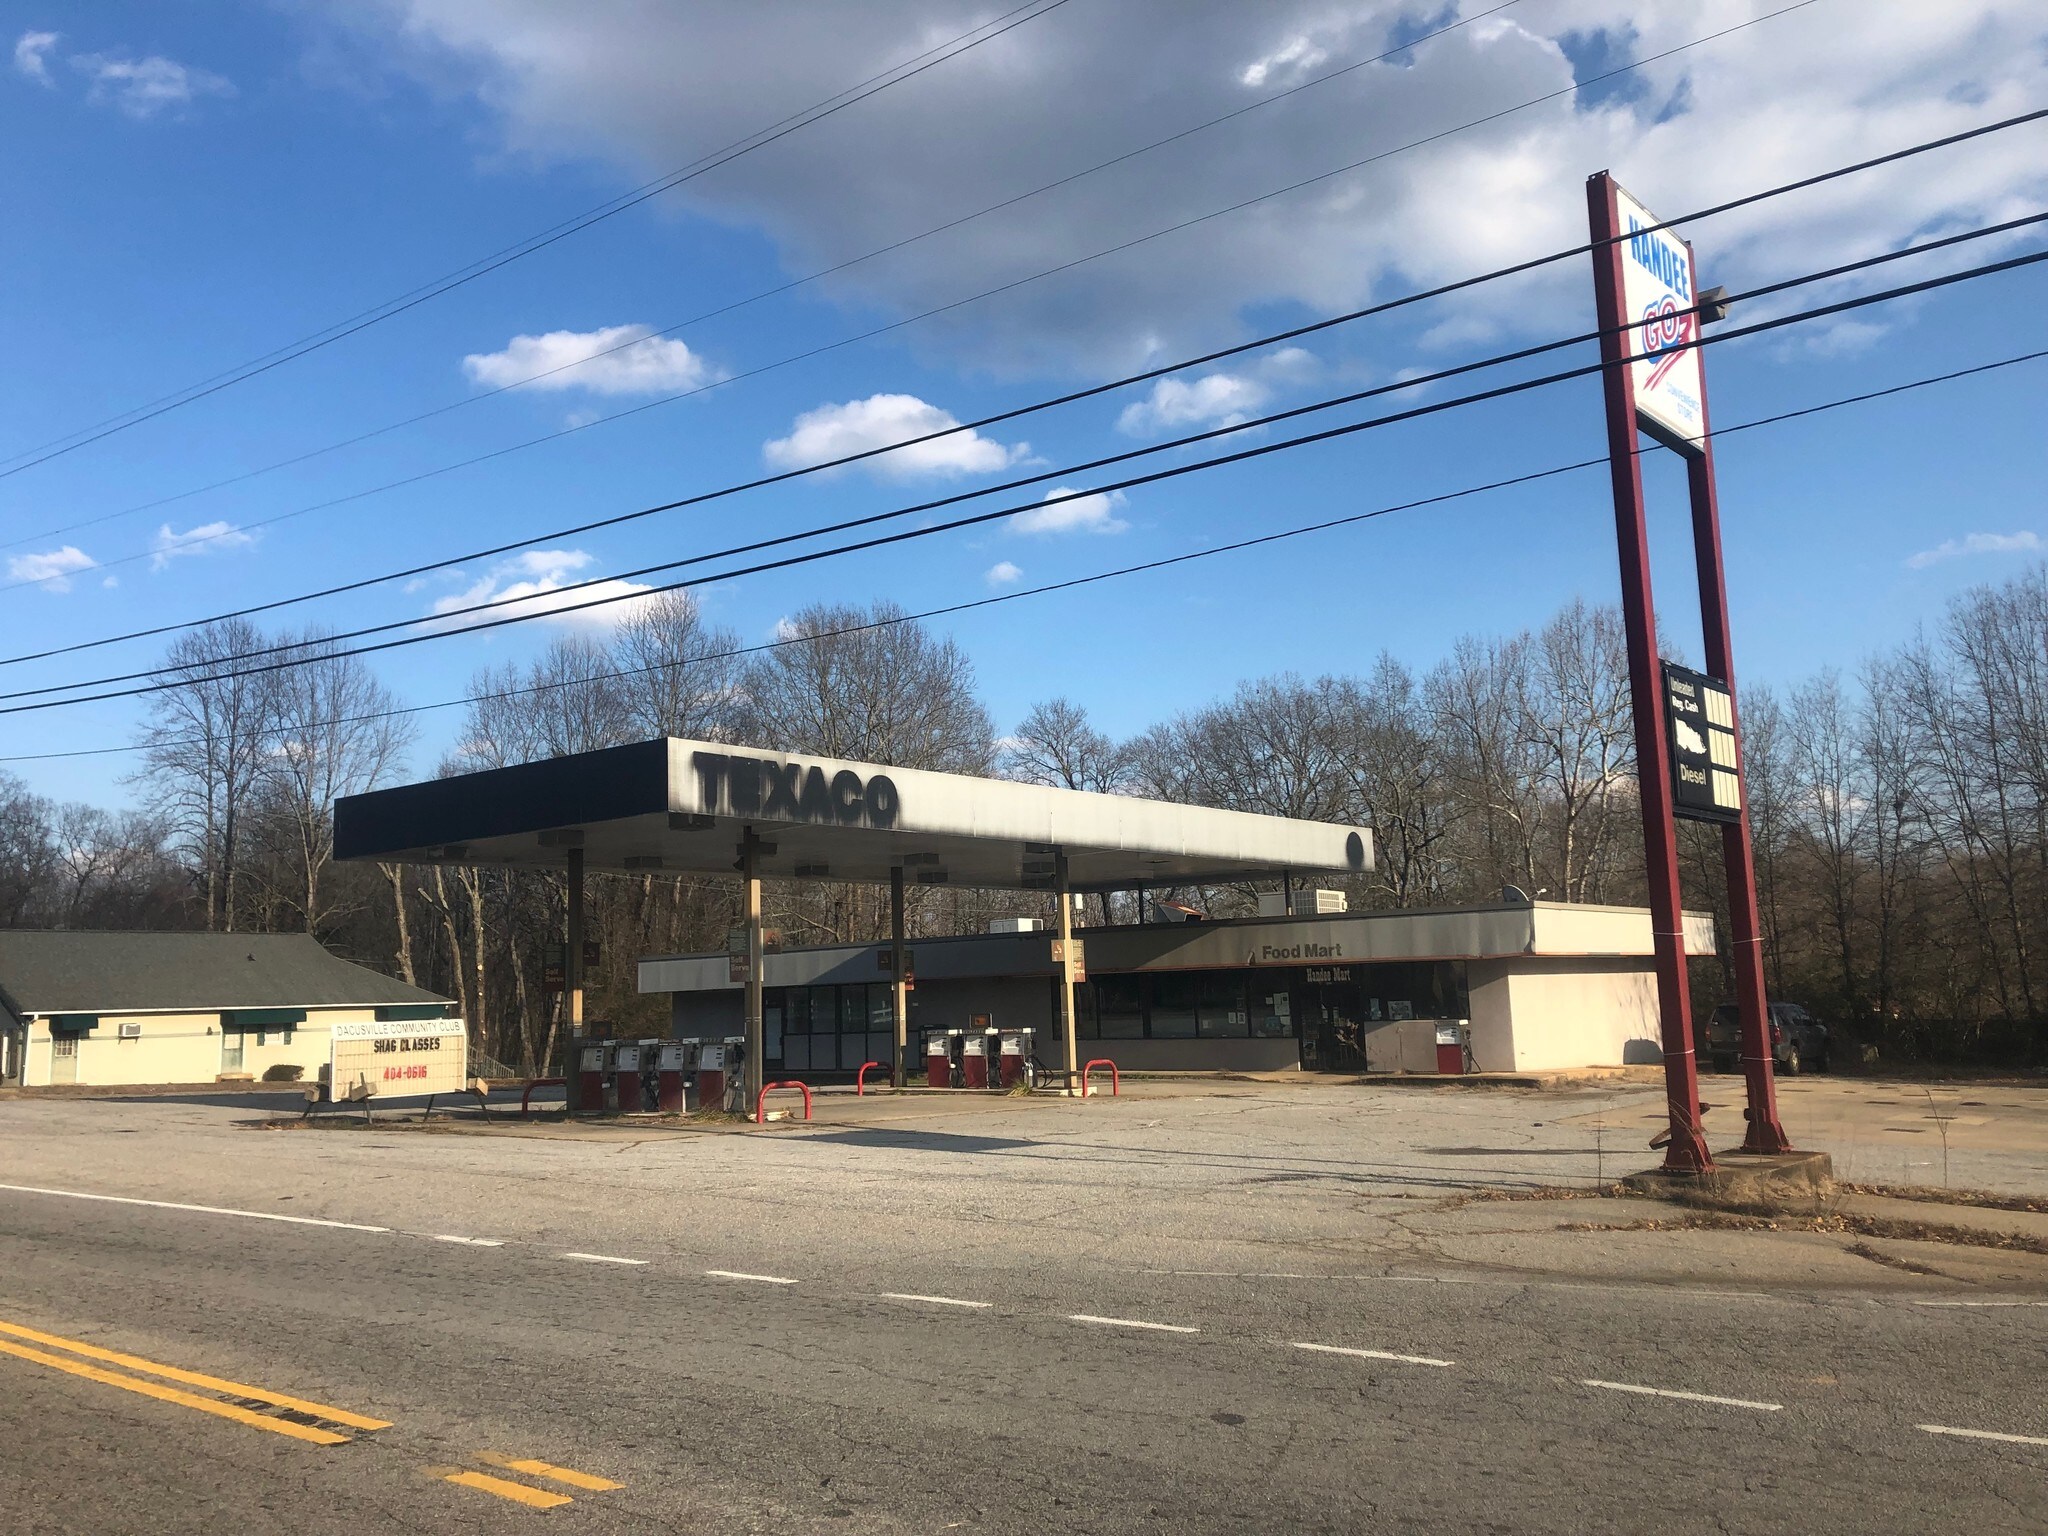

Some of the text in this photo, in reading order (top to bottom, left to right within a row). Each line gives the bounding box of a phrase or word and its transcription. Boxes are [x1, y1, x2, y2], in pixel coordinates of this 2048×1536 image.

[1629, 214, 1689, 302] HANDEE
[1643, 296, 1680, 352] GO
[1685, 699, 1699, 713] Cash
[1680, 763, 1706, 786] Diesel
[693, 750, 899, 828] TEXACO
[1262, 943, 1342, 959] Food Mart
[1333, 967, 1352, 982] Mart
[337, 1021, 460, 1036] DACUSVILLE COMMUNITY CLUB
[374, 1037, 440, 1053] SHAG CLASSES
[383, 1065, 428, 1080] 404-0616
